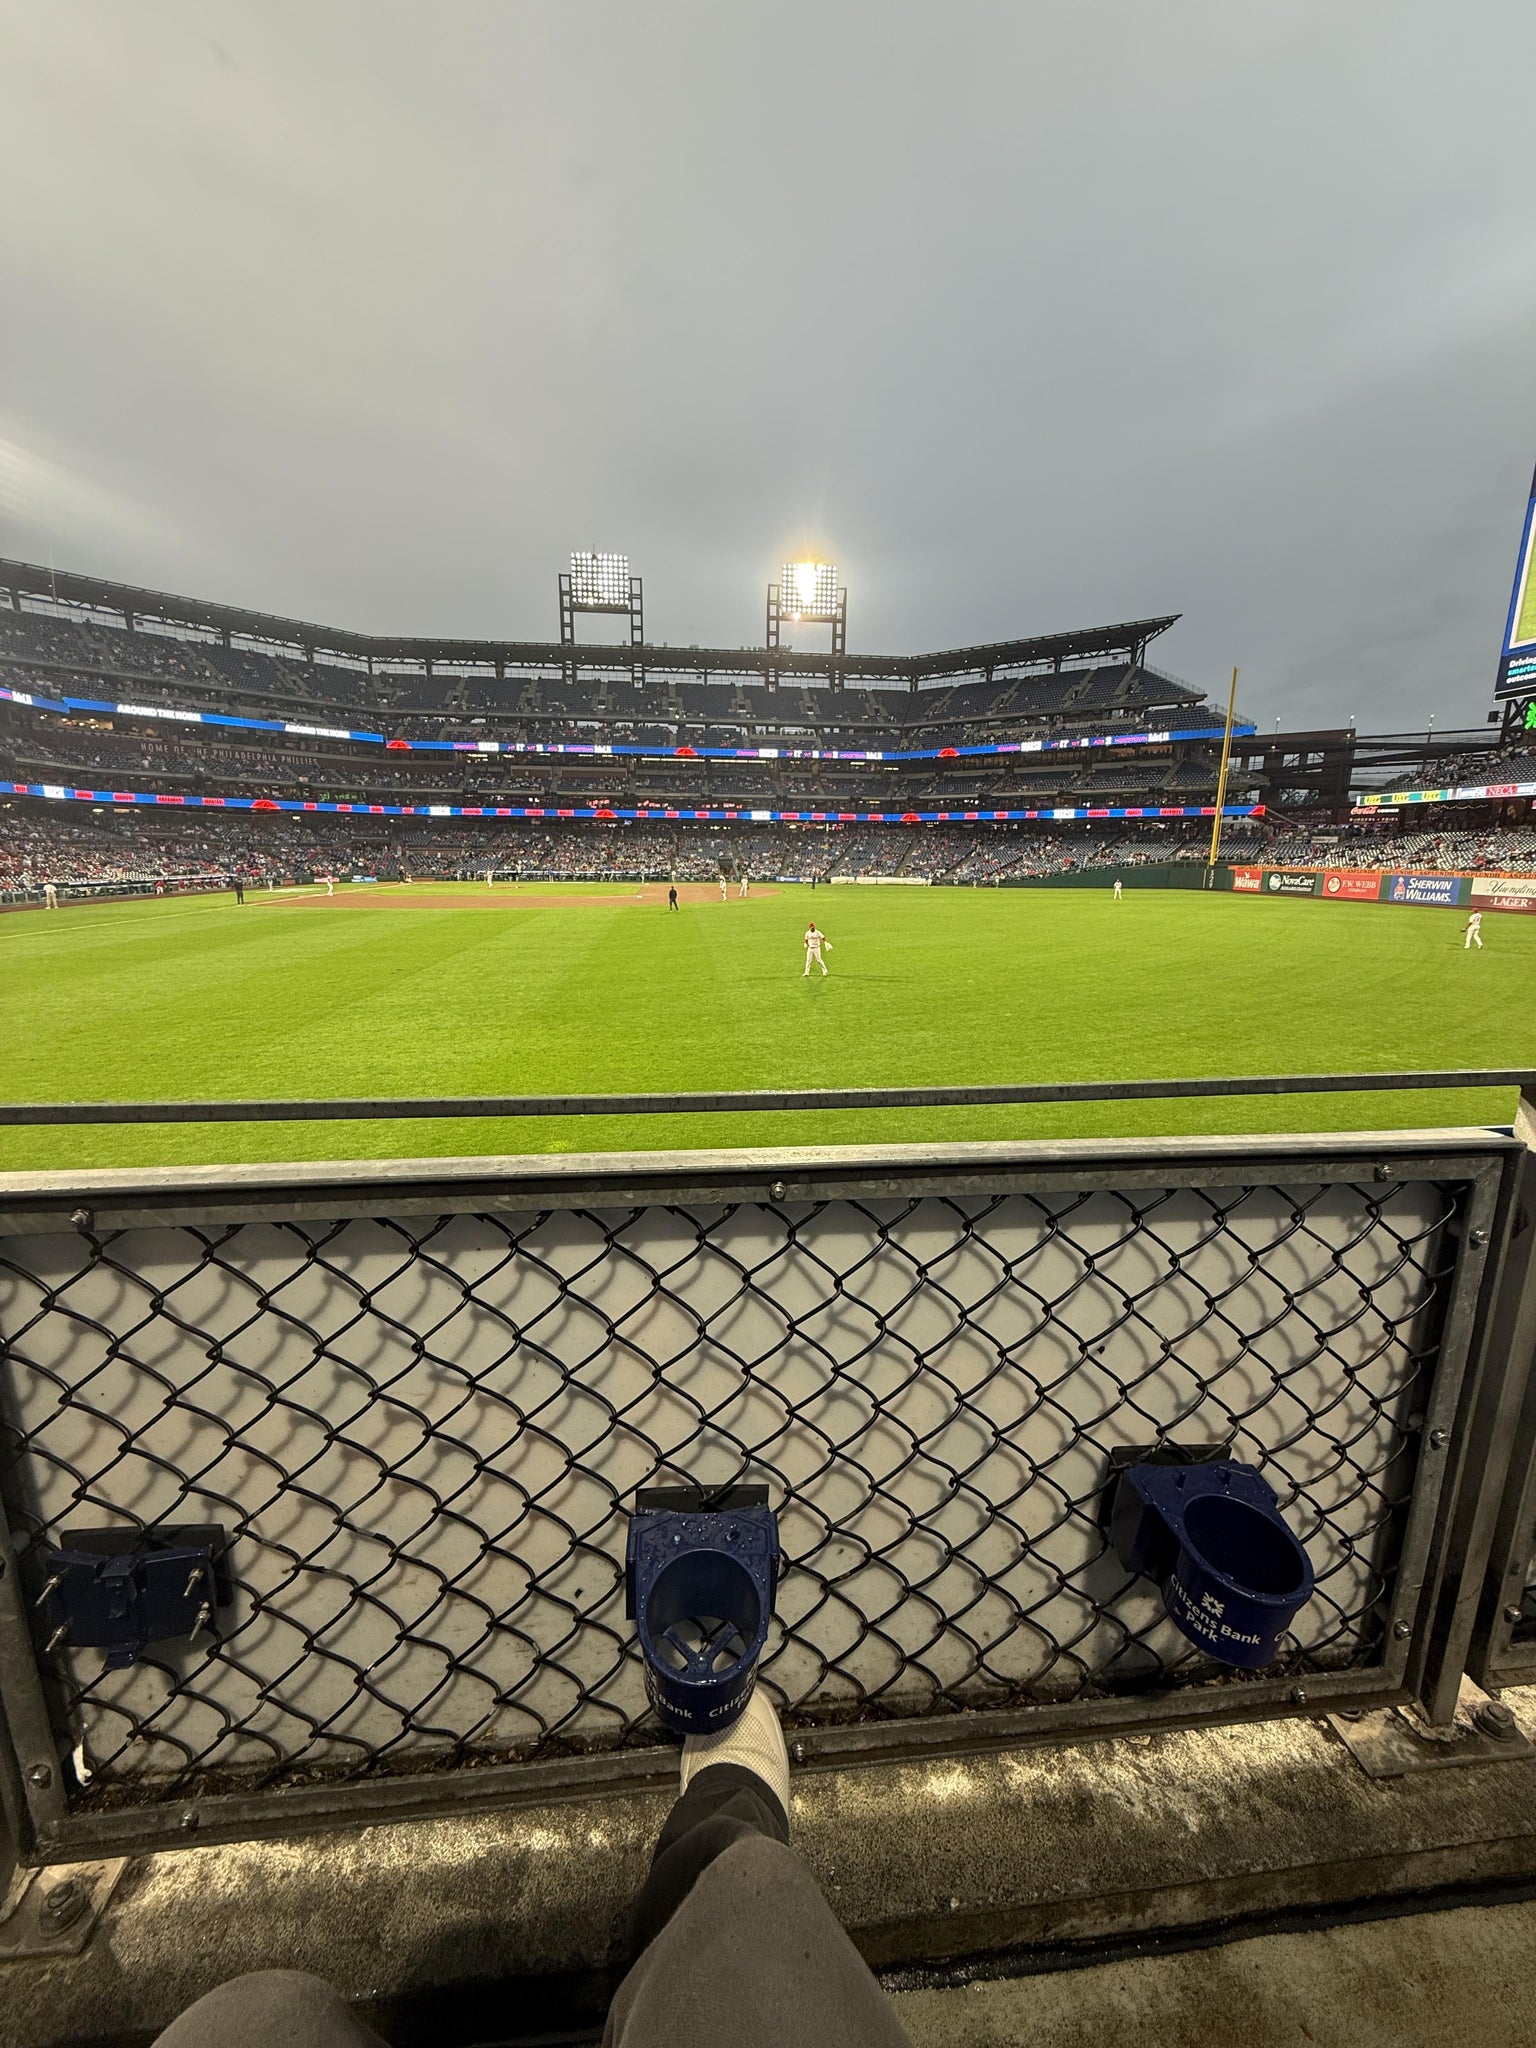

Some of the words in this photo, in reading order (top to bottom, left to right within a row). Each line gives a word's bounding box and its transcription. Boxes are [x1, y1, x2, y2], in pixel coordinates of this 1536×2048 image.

[1235, 876, 1260, 889] Wawa
[1281, 875, 1315, 886] NovaCare
[1408, 878, 1452, 890] SHERWIN
[1493, 897, 1528, 907] LAGER
[1170, 1574, 1218, 1630] Citizens
[1220, 1624, 1262, 1645] Bank
[1186, 1613, 1219, 1643] Park
[659, 1693, 693, 1719] Bank
